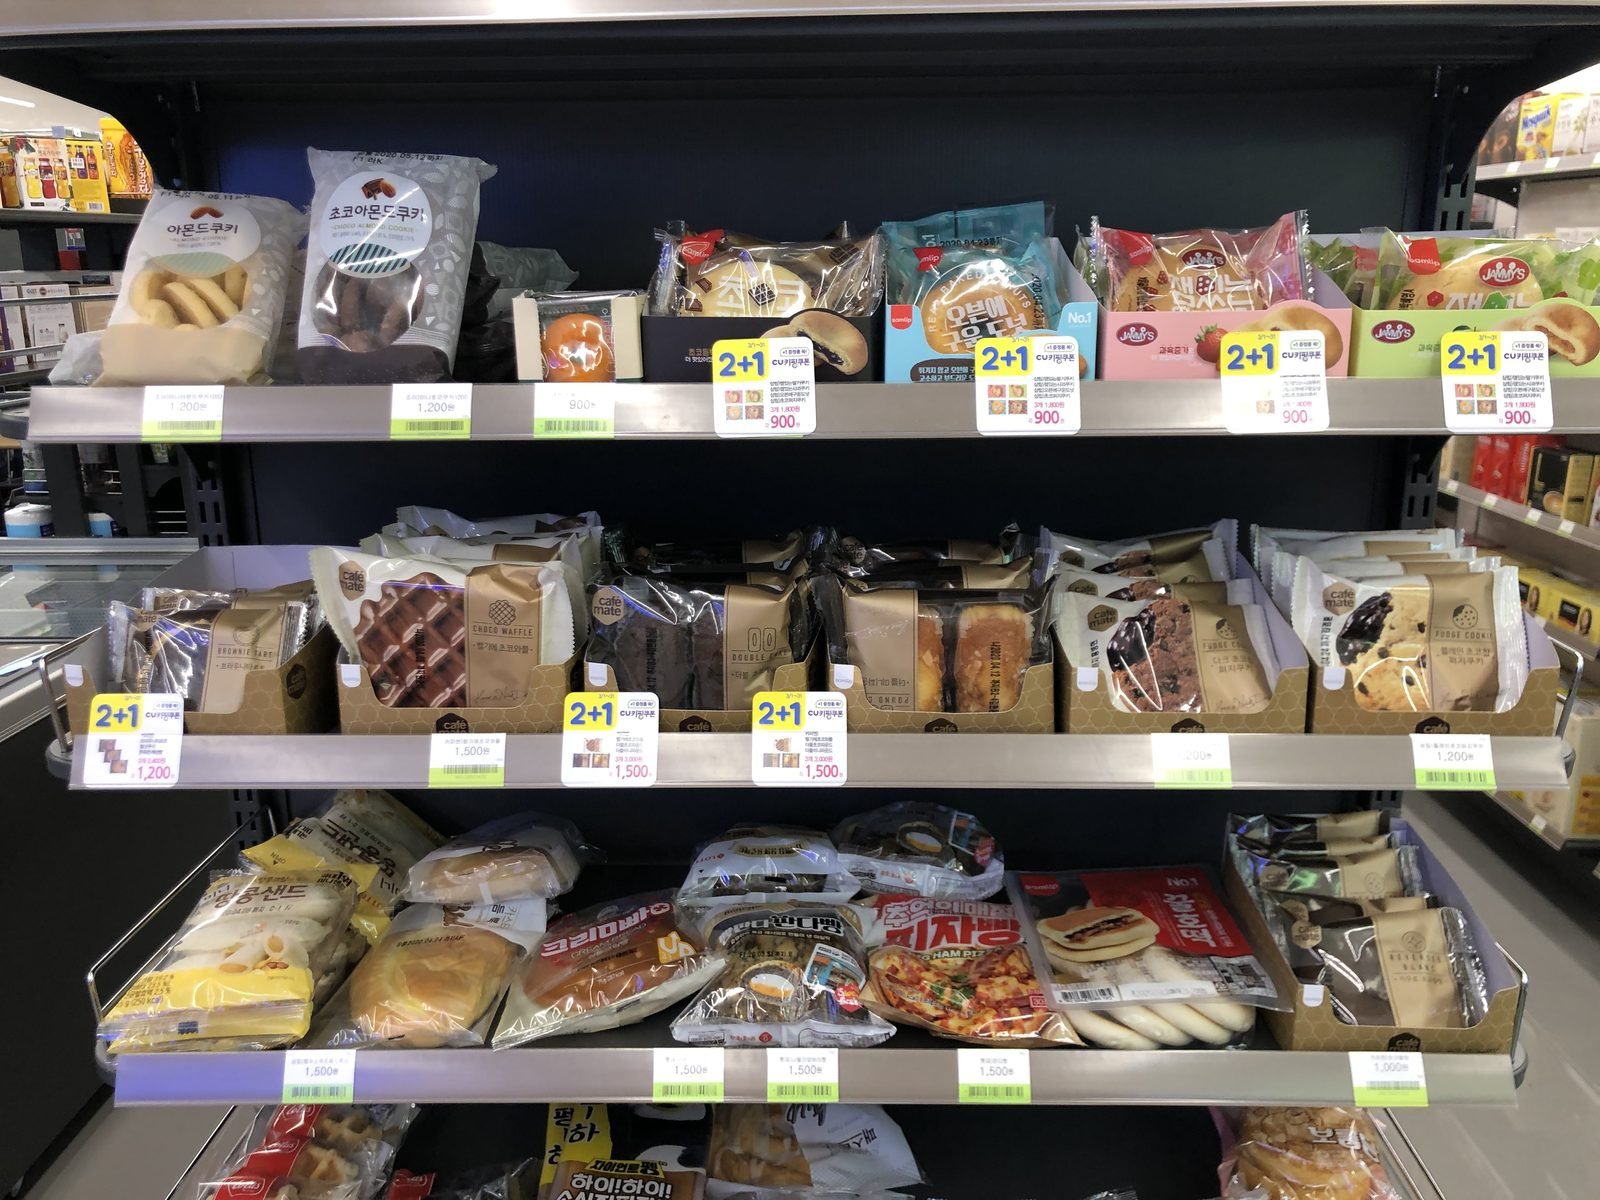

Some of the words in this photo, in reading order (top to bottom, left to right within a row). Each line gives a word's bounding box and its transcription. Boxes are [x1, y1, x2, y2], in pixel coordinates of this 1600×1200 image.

[328, 204, 424, 222] 초코아몬드쿠키
[167, 223, 239, 237] 아몬드쿠키
[1482, 262, 1526, 282] JAMMY'S
[946, 295, 1009, 329] 오븐에
[1067, 311, 1092, 324] No.1
[1120, 327, 1155, 342] JAMMY'S
[1375, 325, 1412, 340] JAMMY'S
[719, 351, 765, 377] 2+1
[982, 346, 1028, 371] 2+1
[1227, 343, 1274, 370] 2+1
[1448, 344, 1496, 369] 2+1
[342, 570, 364, 581] café
[599, 596, 622, 607] café
[1325, 598, 1355, 608] mate
[593, 605, 622, 617] mate
[1089, 617, 1117, 628] mate
[472, 624, 498, 634] CHOCO
[501, 626, 533, 637] WAFFLE
[1435, 630, 1461, 639] FUDGE
[216, 648, 250, 656] BROWNIE
[732, 653, 765, 662] DOUBLE
[96, 704, 139, 727] 2+1
[570, 702, 612, 726] 2+1
[758, 701, 800, 726] 2+1
[443, 719, 467, 730] café
[687, 722, 710, 732] café
[213, 884, 309, 909] 땅콩샌드
[882, 915, 1022, 951] 피자빵
[932, 950, 962, 959] HAM
[570, 1172, 673, 1198] 하이!하이!
